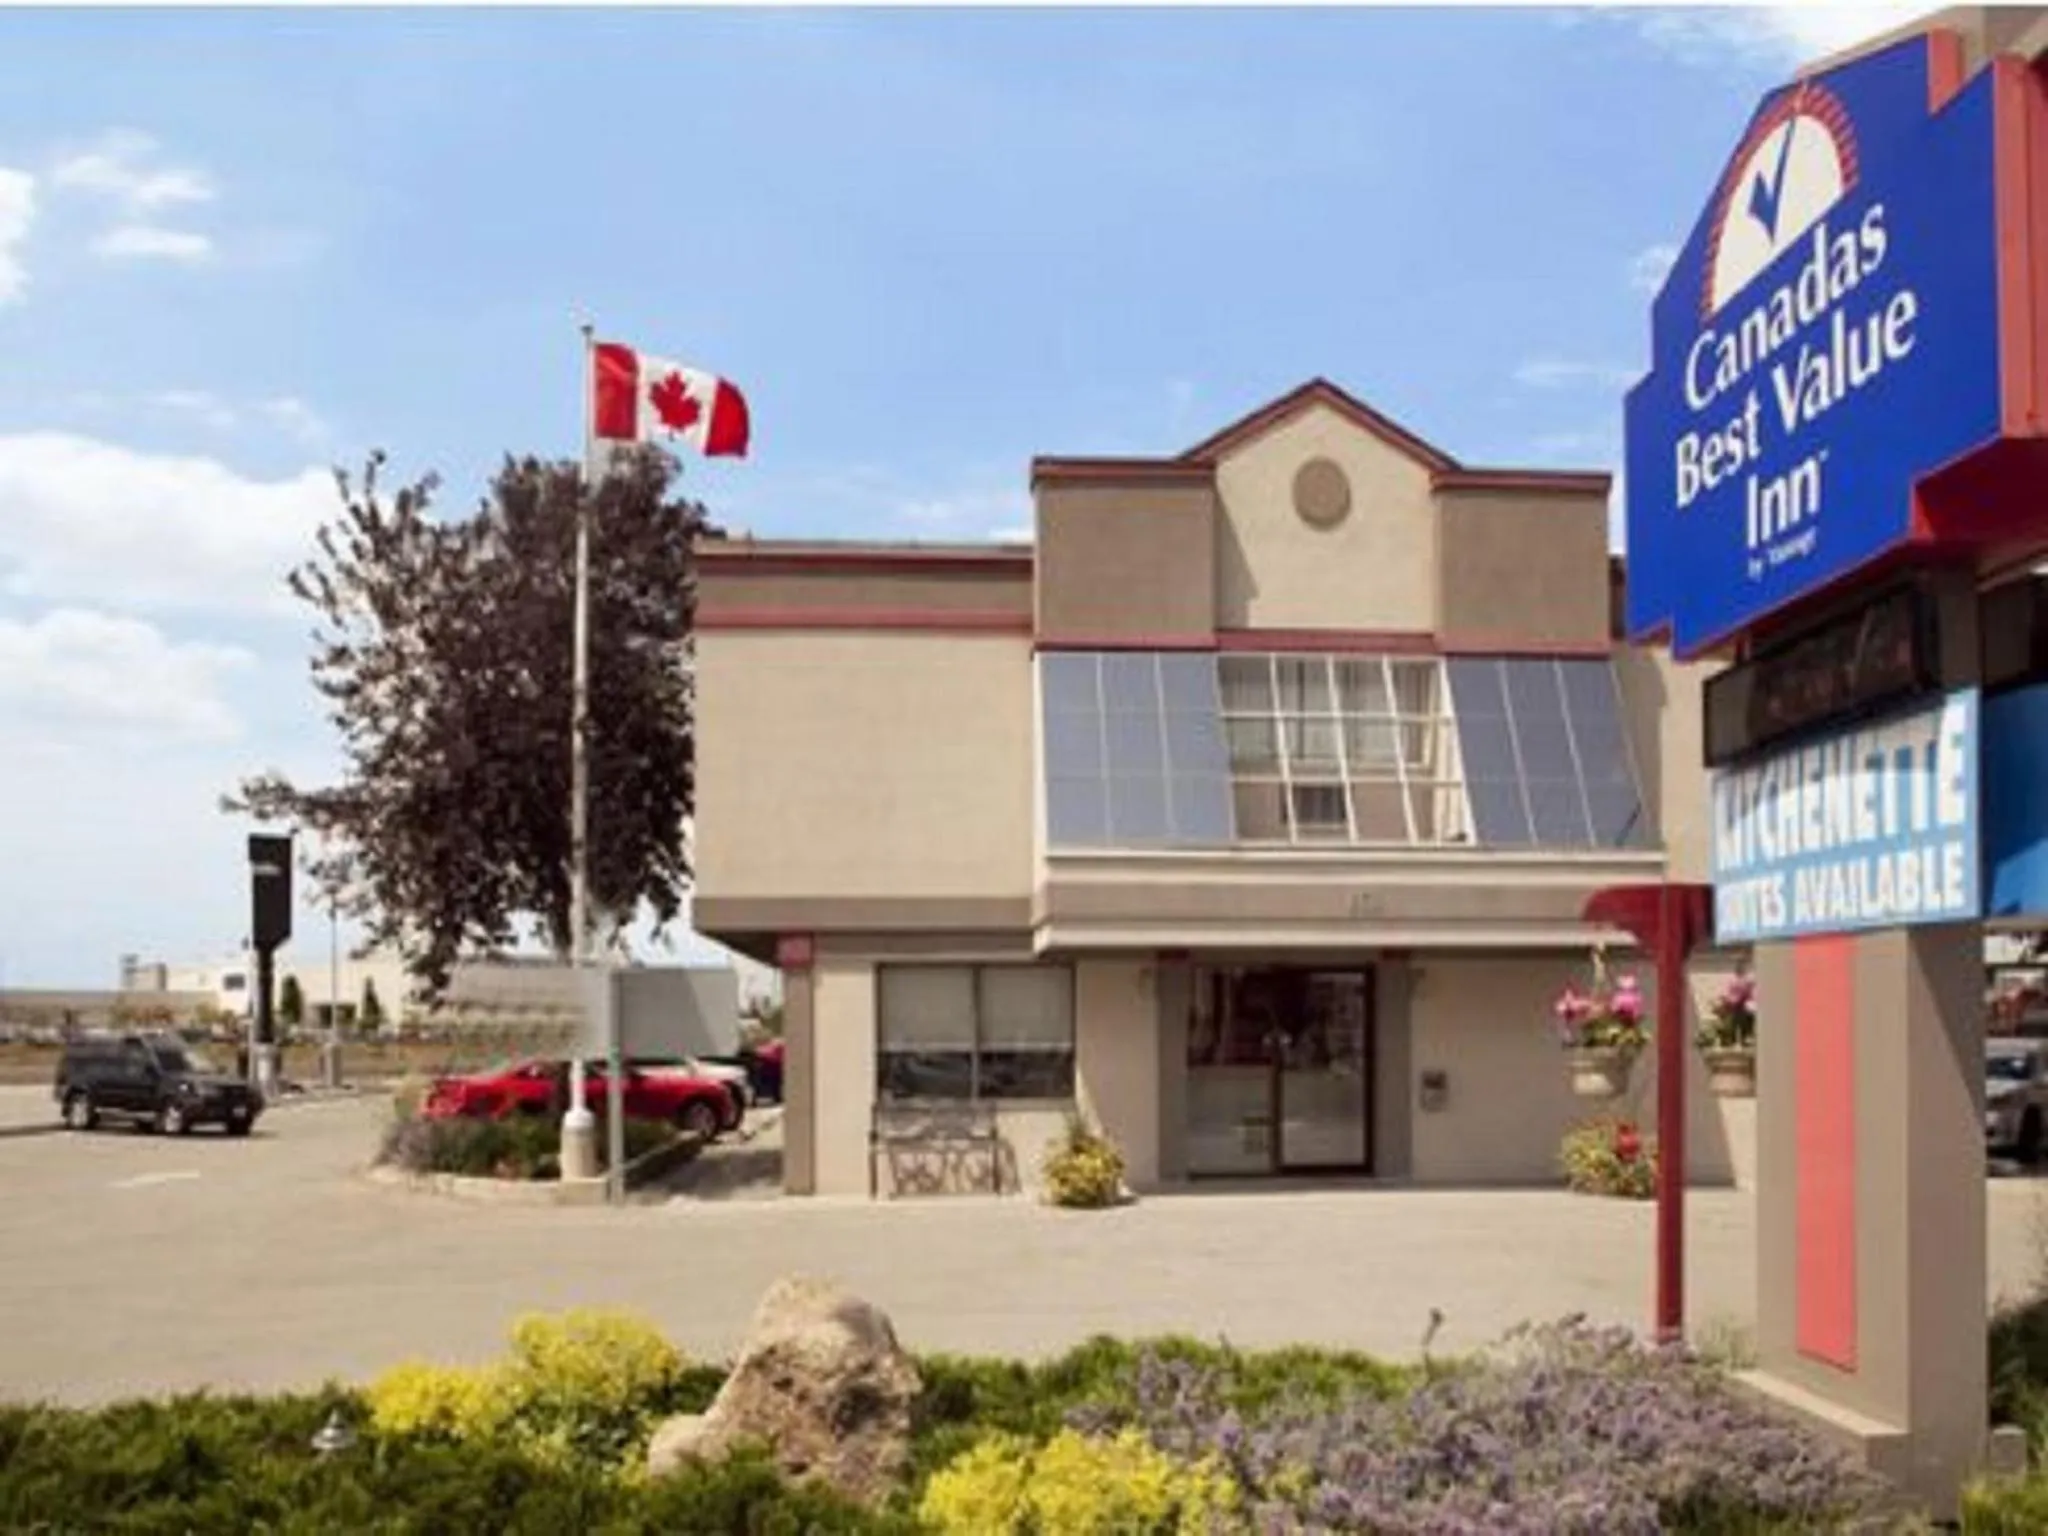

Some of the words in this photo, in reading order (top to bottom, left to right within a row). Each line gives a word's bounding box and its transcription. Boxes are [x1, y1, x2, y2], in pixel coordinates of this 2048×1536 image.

[1685, 203, 1888, 412] Canadas
[1676, 388, 1762, 509] Best
[1772, 290, 1918, 435] Value
[1747, 456, 1820, 548] Inn
[1793, 841, 1966, 926] AVAILABLE
